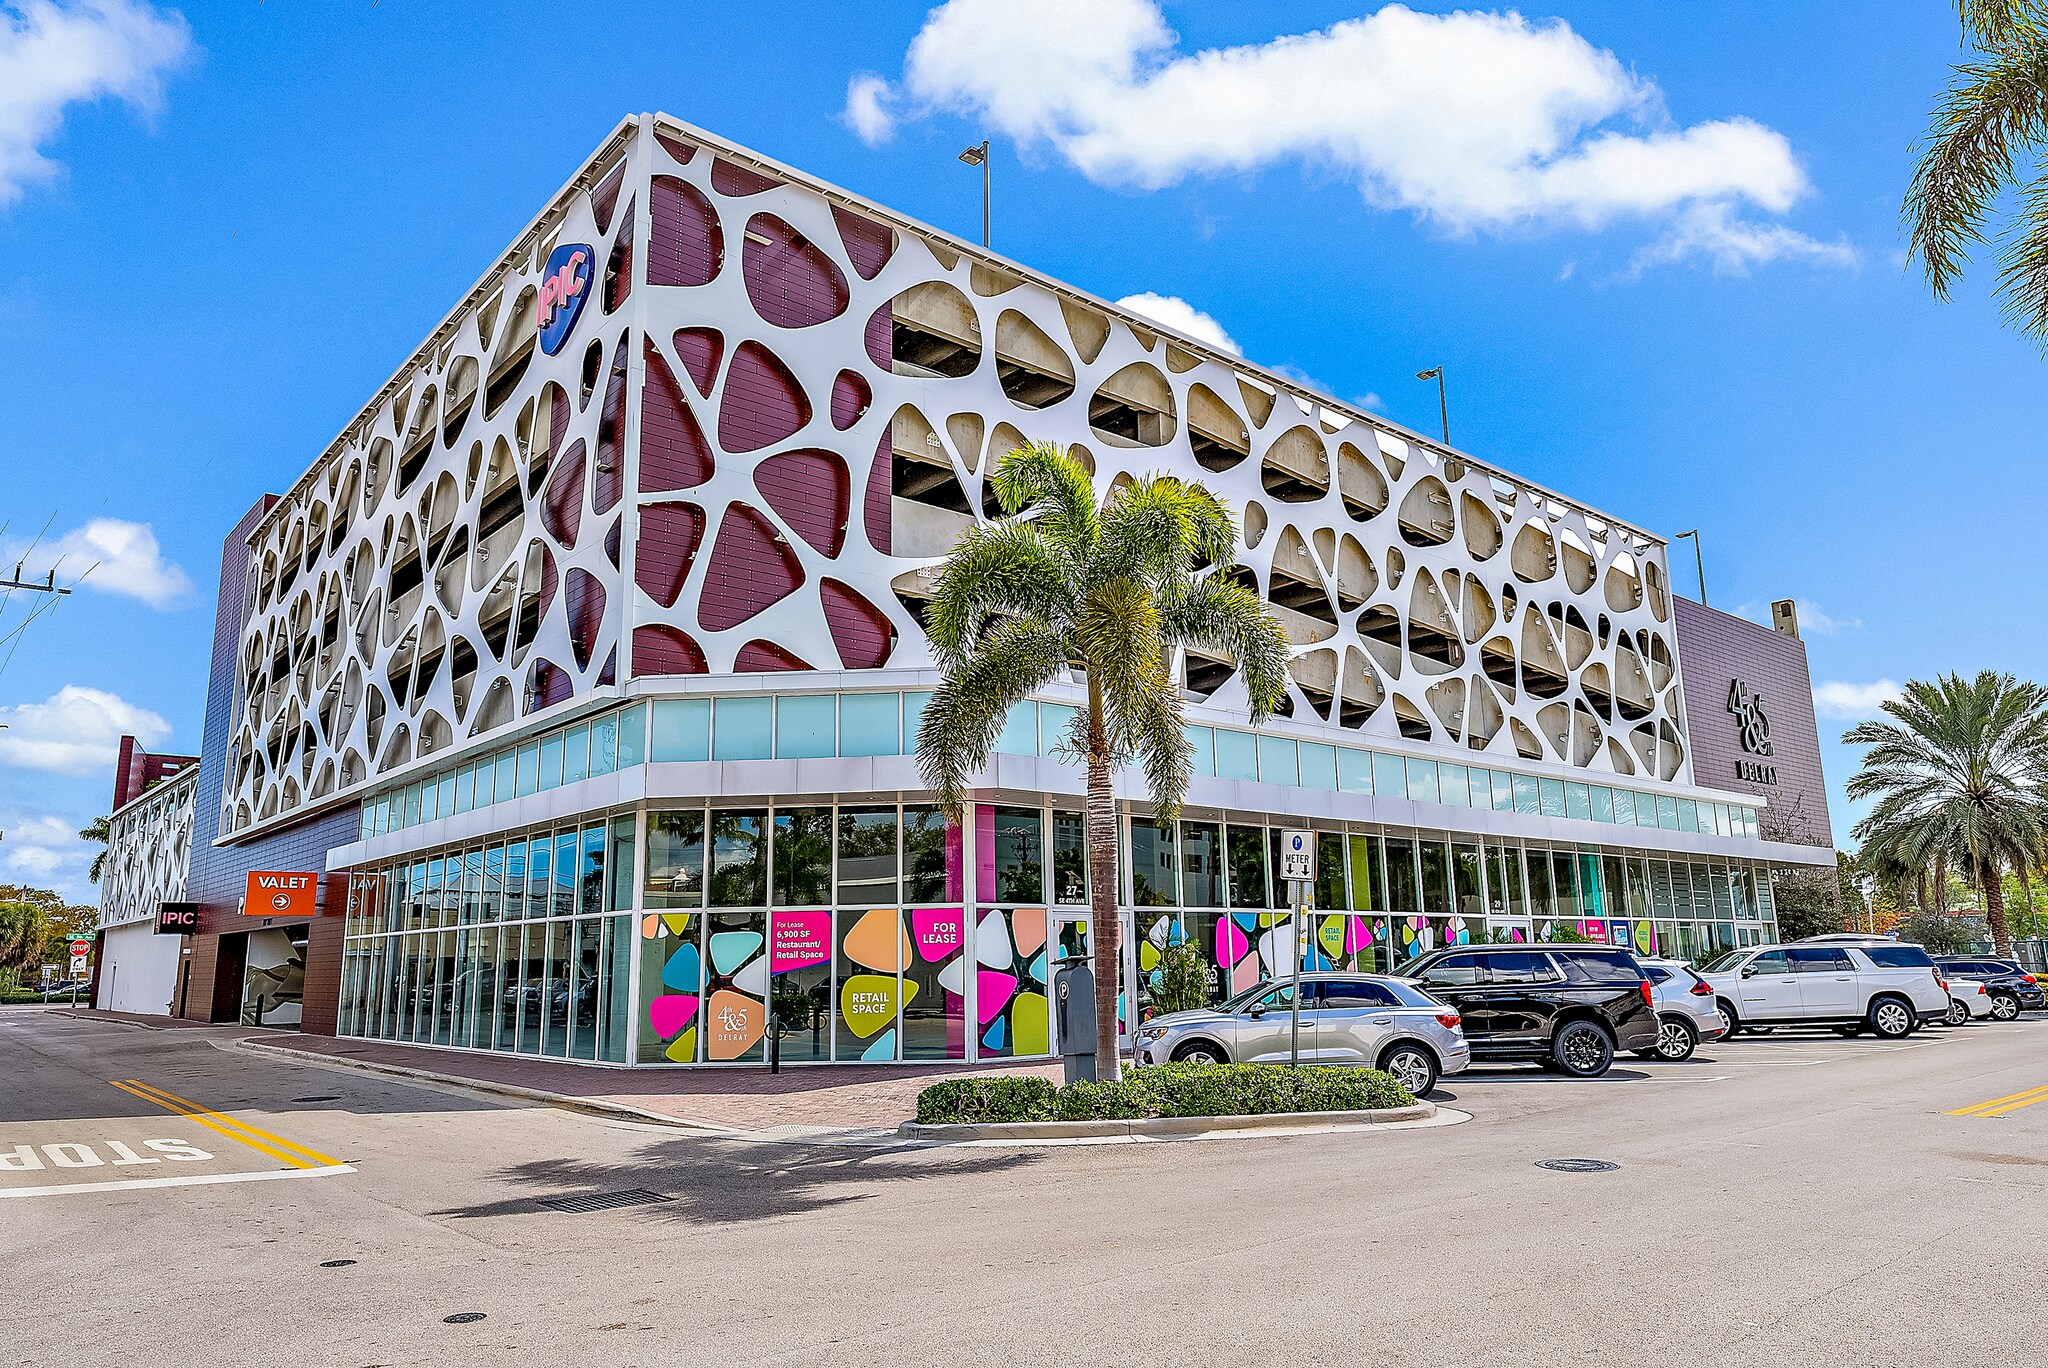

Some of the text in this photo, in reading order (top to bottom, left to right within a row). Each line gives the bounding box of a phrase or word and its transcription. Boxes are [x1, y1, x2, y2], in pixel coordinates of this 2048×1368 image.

[537, 251, 586, 328] IPIC
[1286, 853, 1310, 864] METER
[258, 876, 309, 889] VALET
[1066, 885, 1078, 896] 27
[162, 911, 195, 925] IPIC
[933, 922, 957, 933] FOR
[776, 930, 811, 940] 6,900 SF
[922, 933, 957, 944] LEASE
[71, 943, 89, 952] STOP
[776, 940, 821, 949] Restaurant/
[776, 950, 825, 961] Retail Space
[1061, 984, 1067, 997] P
[852, 992, 889, 1003] RETAIL
[852, 1003, 886, 1014] SPACE
[717, 1033, 748, 1041] DELRAY
[0, 1138, 216, 1171] STOP
